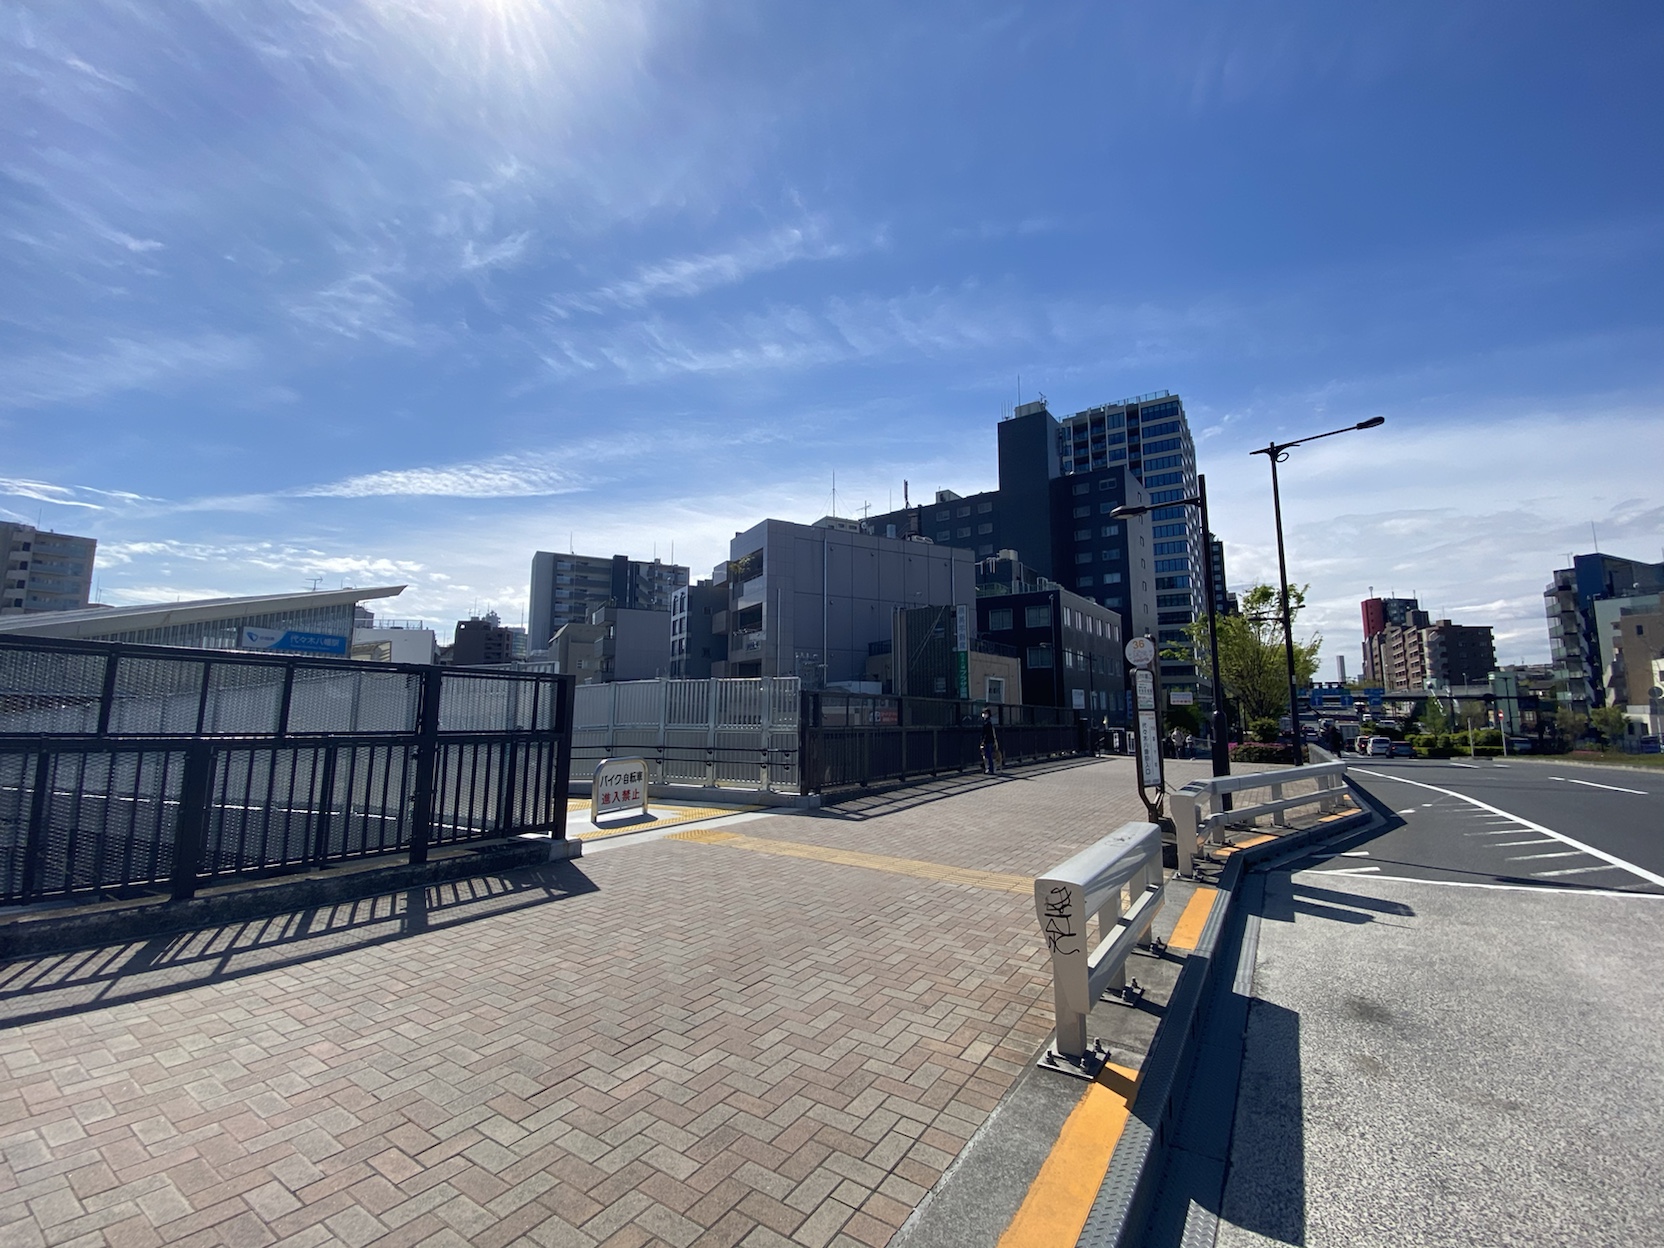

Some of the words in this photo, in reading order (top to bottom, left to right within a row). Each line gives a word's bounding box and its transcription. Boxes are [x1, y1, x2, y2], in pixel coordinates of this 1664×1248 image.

[1132, 640, 1145, 649] 36
[601, 788, 640, 805] 進入禁止
